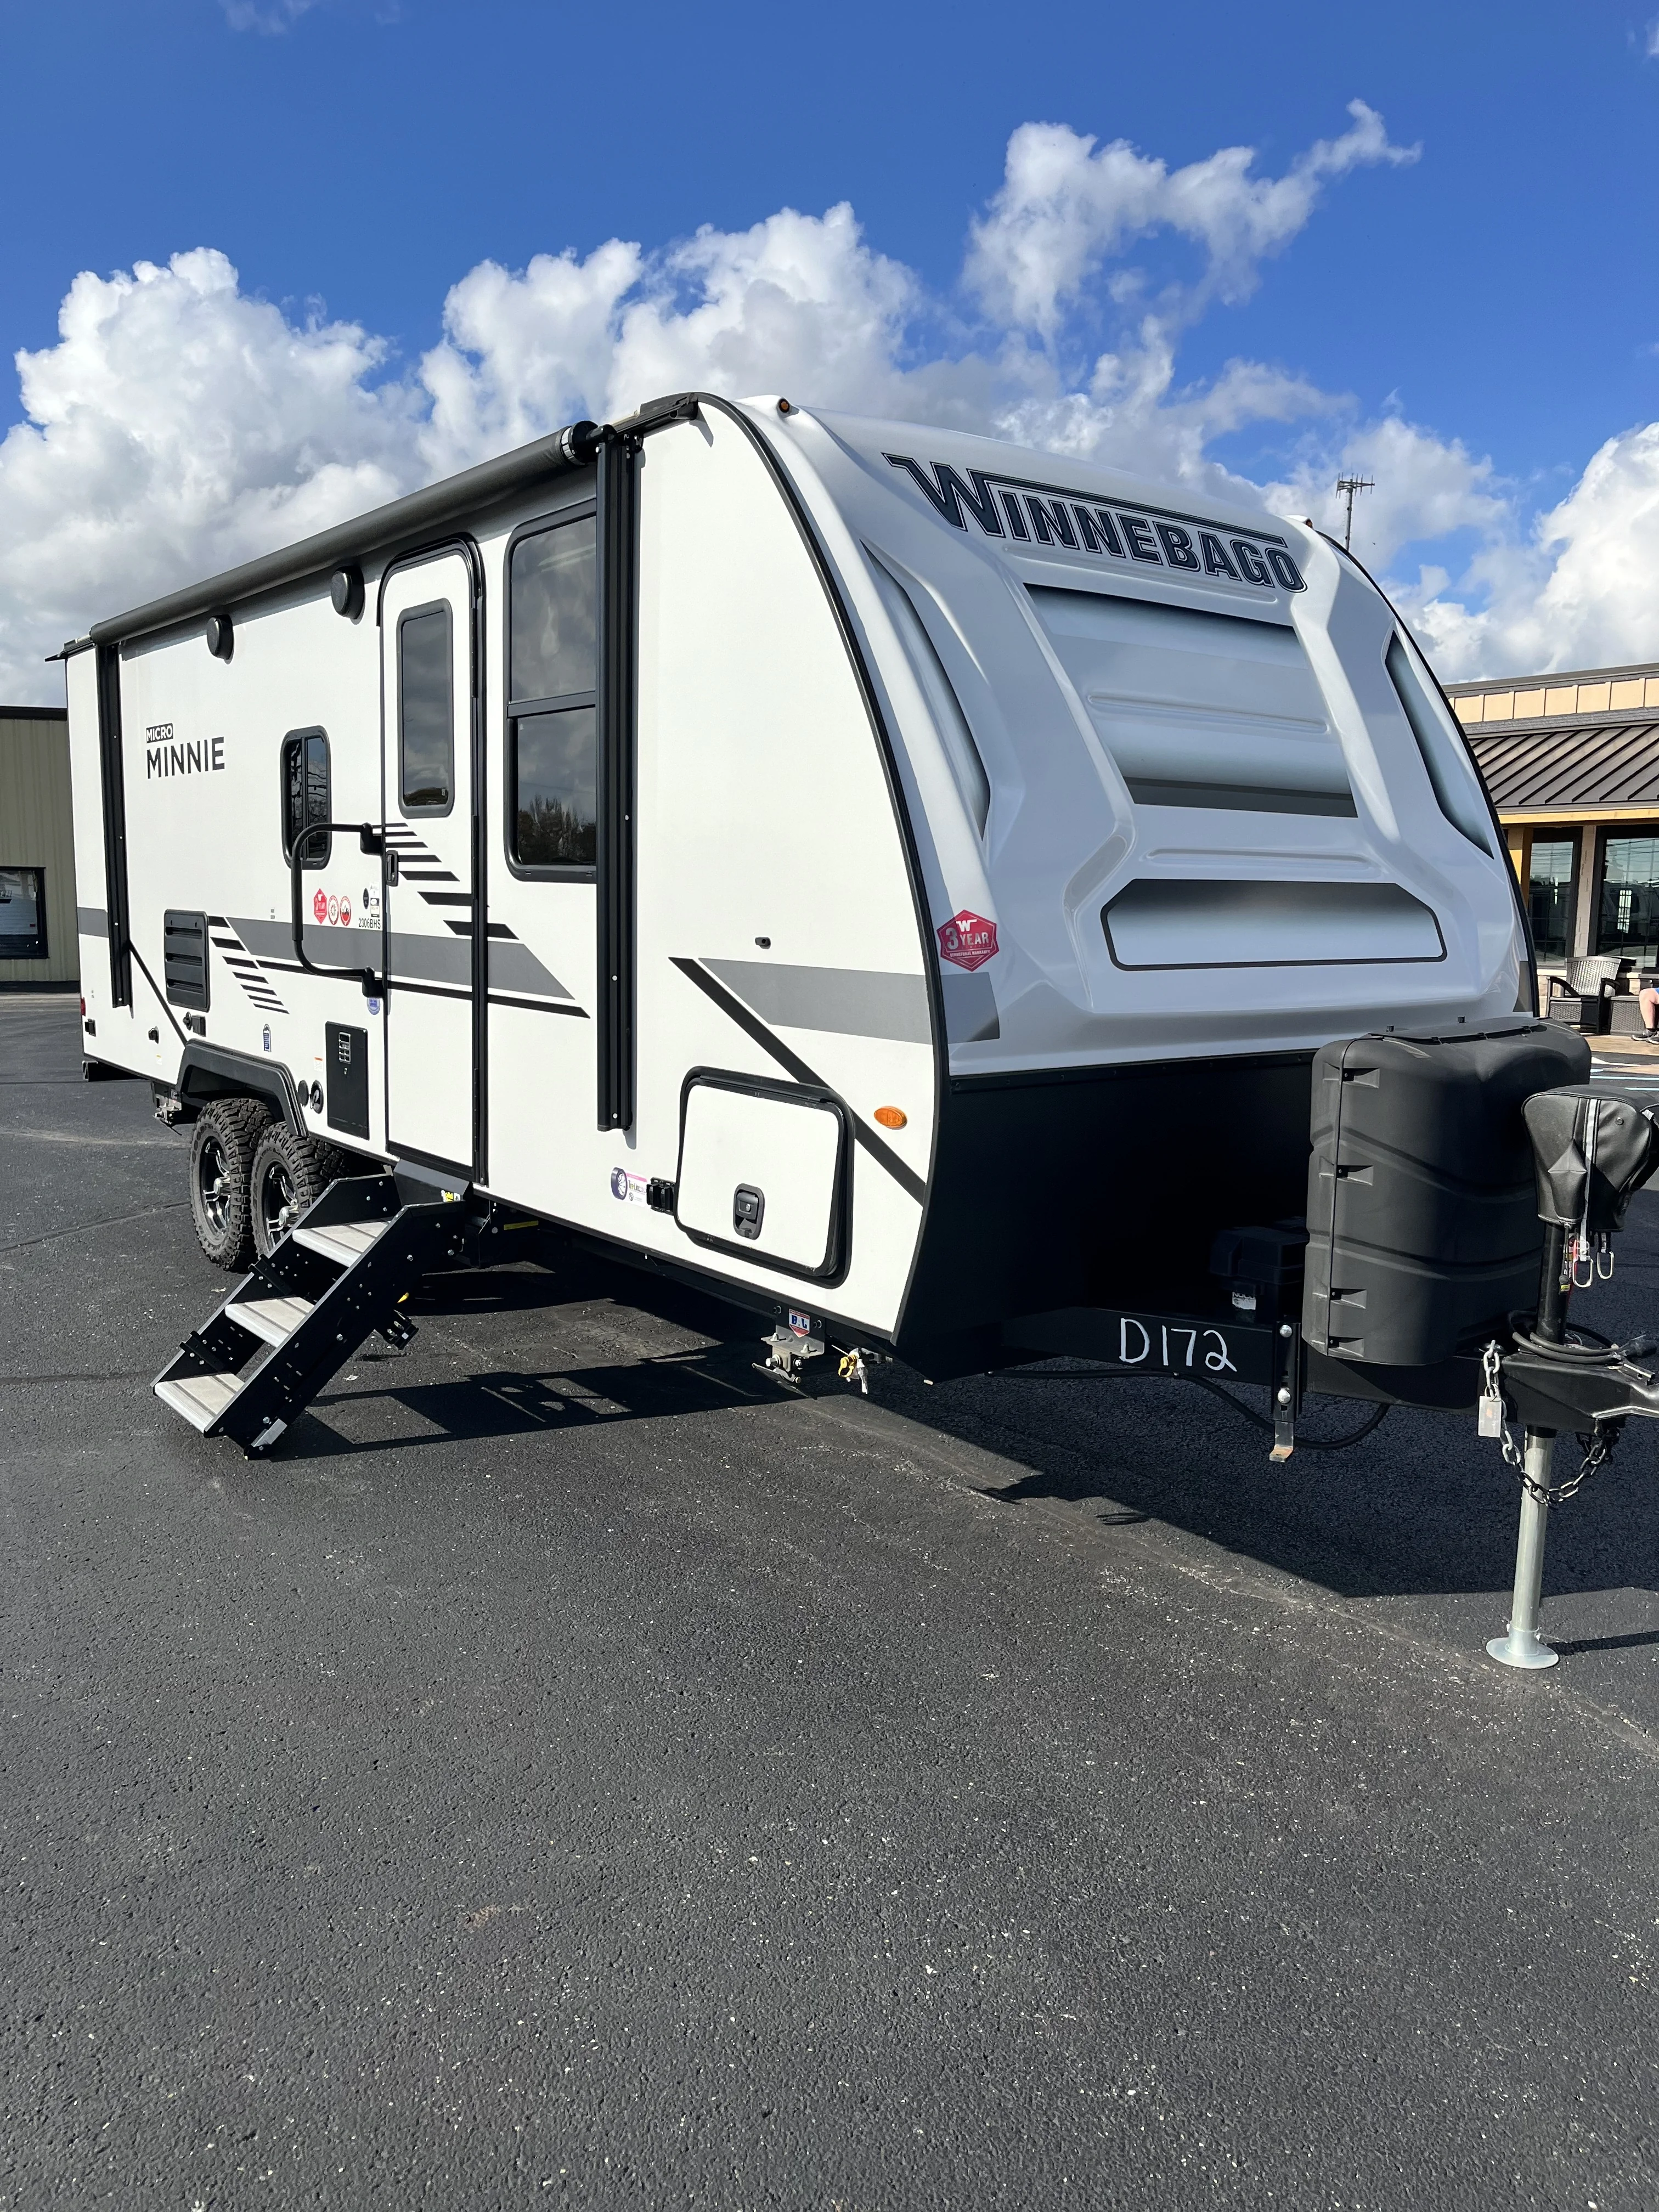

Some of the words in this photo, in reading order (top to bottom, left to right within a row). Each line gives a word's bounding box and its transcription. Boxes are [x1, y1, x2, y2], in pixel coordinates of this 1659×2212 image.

[881, 452, 1307, 592] WINNEBAGO
[146, 725, 173, 741] MICRO
[147, 736, 225, 779] MINNIE
[358, 917, 381, 929] 2306BHS
[945, 927, 958, 950] 3
[960, 932, 989, 945] YEAR
[1119, 1318, 1237, 1372] D172
